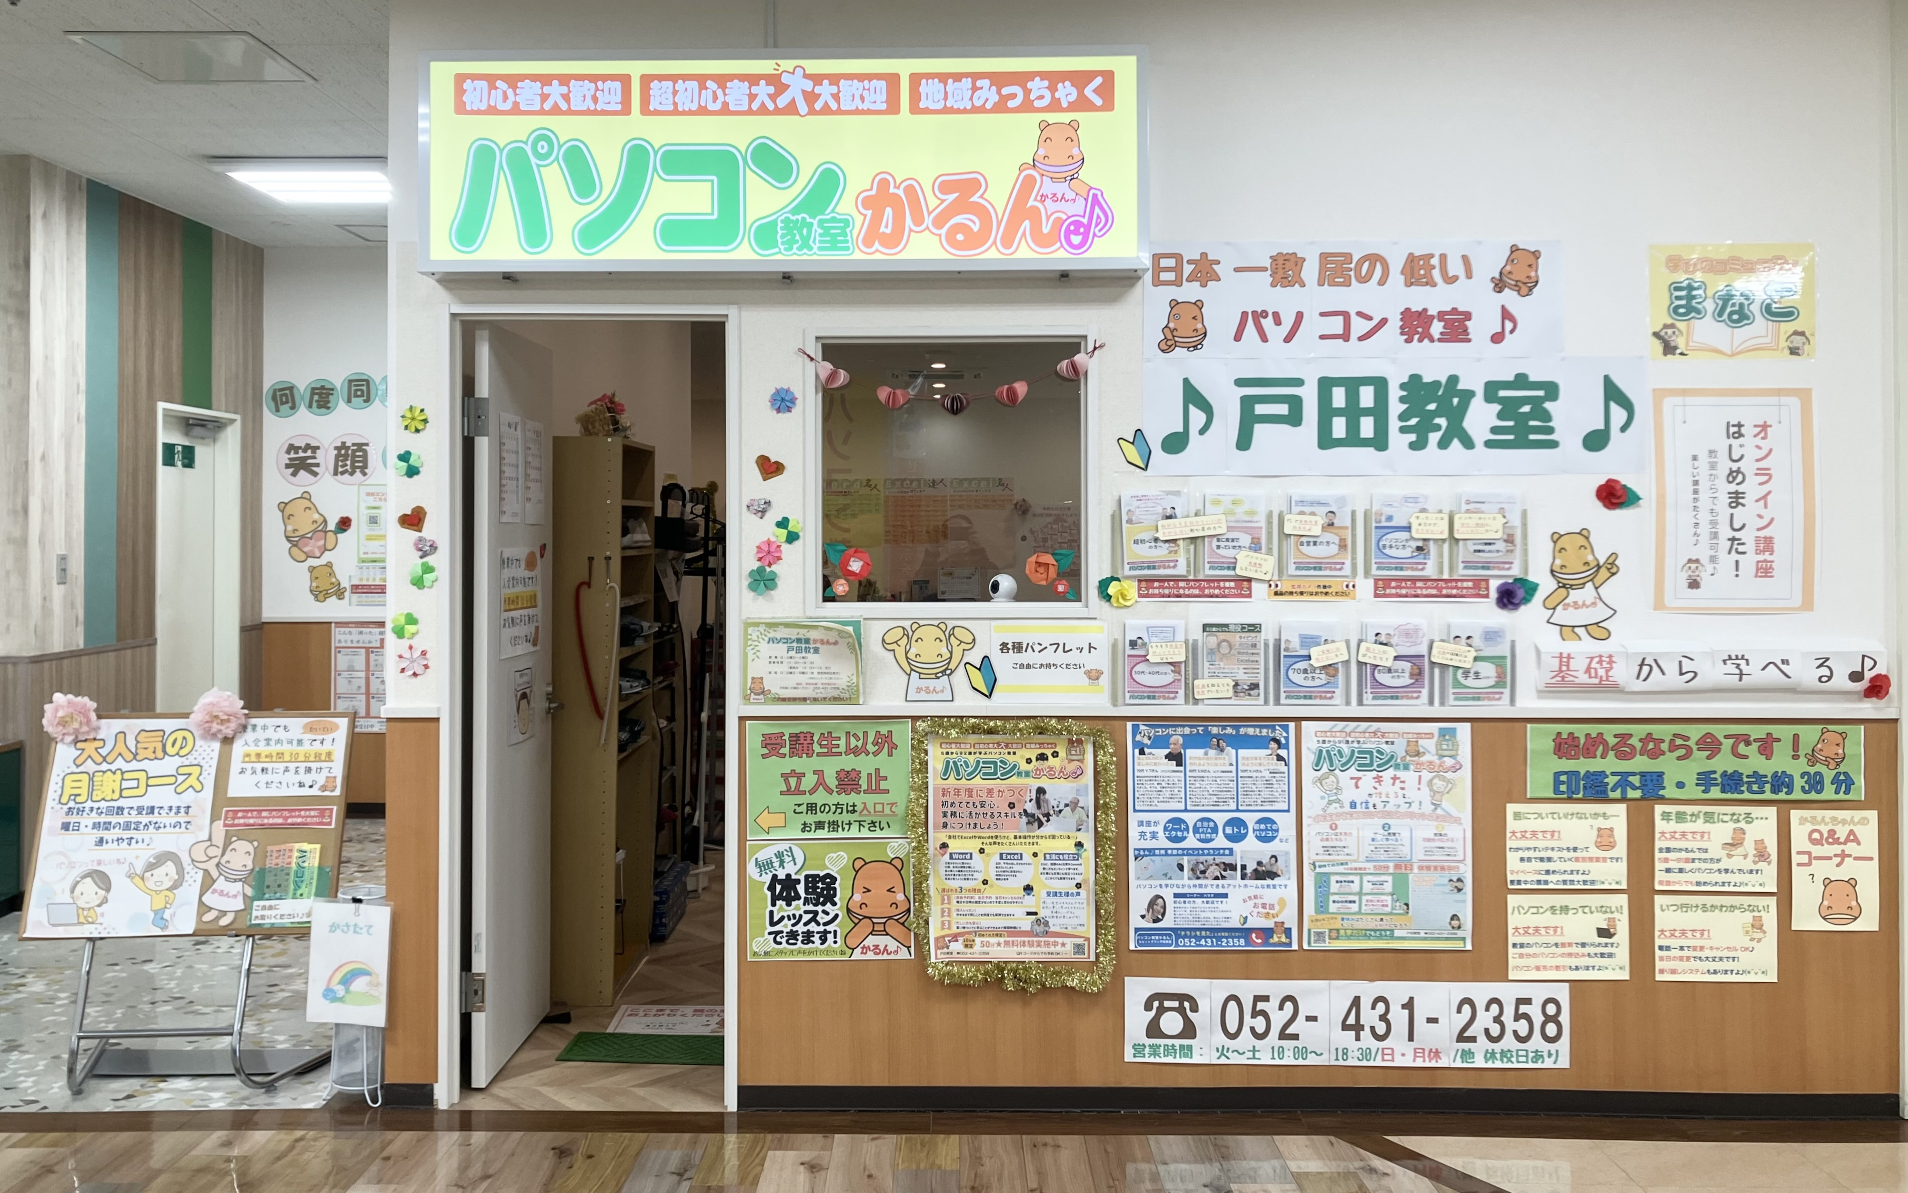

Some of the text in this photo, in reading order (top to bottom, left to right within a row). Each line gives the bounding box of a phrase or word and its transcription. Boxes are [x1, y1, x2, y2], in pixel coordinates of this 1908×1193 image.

[462, 79, 623, 112] 初心者大歓迎
[919, 76, 1104, 111] 地域みっちゃく
[450, 127, 846, 256] パソコン
[1233, 372, 1560, 452] 戸田教室
[285, 441, 369, 478] 笑顔
[1726, 420, 1747, 579] はじめました！
[1753, 420, 1776, 579] オンライン講座
[786, 645, 820, 654] 戸田教室
[998, 641, 1098, 656] 各種パンフレット
[1011, 662, 1086, 671] ご自由にお持ちください
[74, 728, 195, 766] 大人気の
[242, 738, 336, 747] 入会案内可能です！
[761, 730, 898, 759] 受講生以外
[1552, 732, 1801, 761] 始めるなら今です！
[1313, 745, 1397, 771] パソコン
[238, 766, 334, 775] お気軽に声を掛けて
[59, 765, 204, 805] 月謝コース
[780, 768, 890, 796] 立入禁止
[1350, 774, 1422, 791] できた！
[65, 805, 193, 816] お好きな回数で受講できます
[793, 801, 899, 815] ご用の方は入口で
[941, 810, 1024, 820] 実務に活かせるスキルを
[60, 821, 193, 832] 曜日・時間の固定がないので
[801, 819, 891, 833] お声掛け下さい
[941, 821, 1005, 830] 身につけましょう！
[1166, 823, 1187, 831] ワード
[1798, 815, 1870, 827] かるんちゃんの
[1138, 831, 1159, 841] 充実
[1808, 828, 1861, 846] Q&A
[755, 845, 798, 877] 無料
[1796, 849, 1874, 868] コーナー
[767, 872, 838, 907] 体験
[1249, 910, 1279, 919] ください
[1252, 902, 1276, 911] お電話
[768, 909, 840, 928] レッスン
[328, 922, 374, 936] かさたて
[860, 943, 893, 956] かるん
[1178, 938, 1246, 946] 052-431-2358
